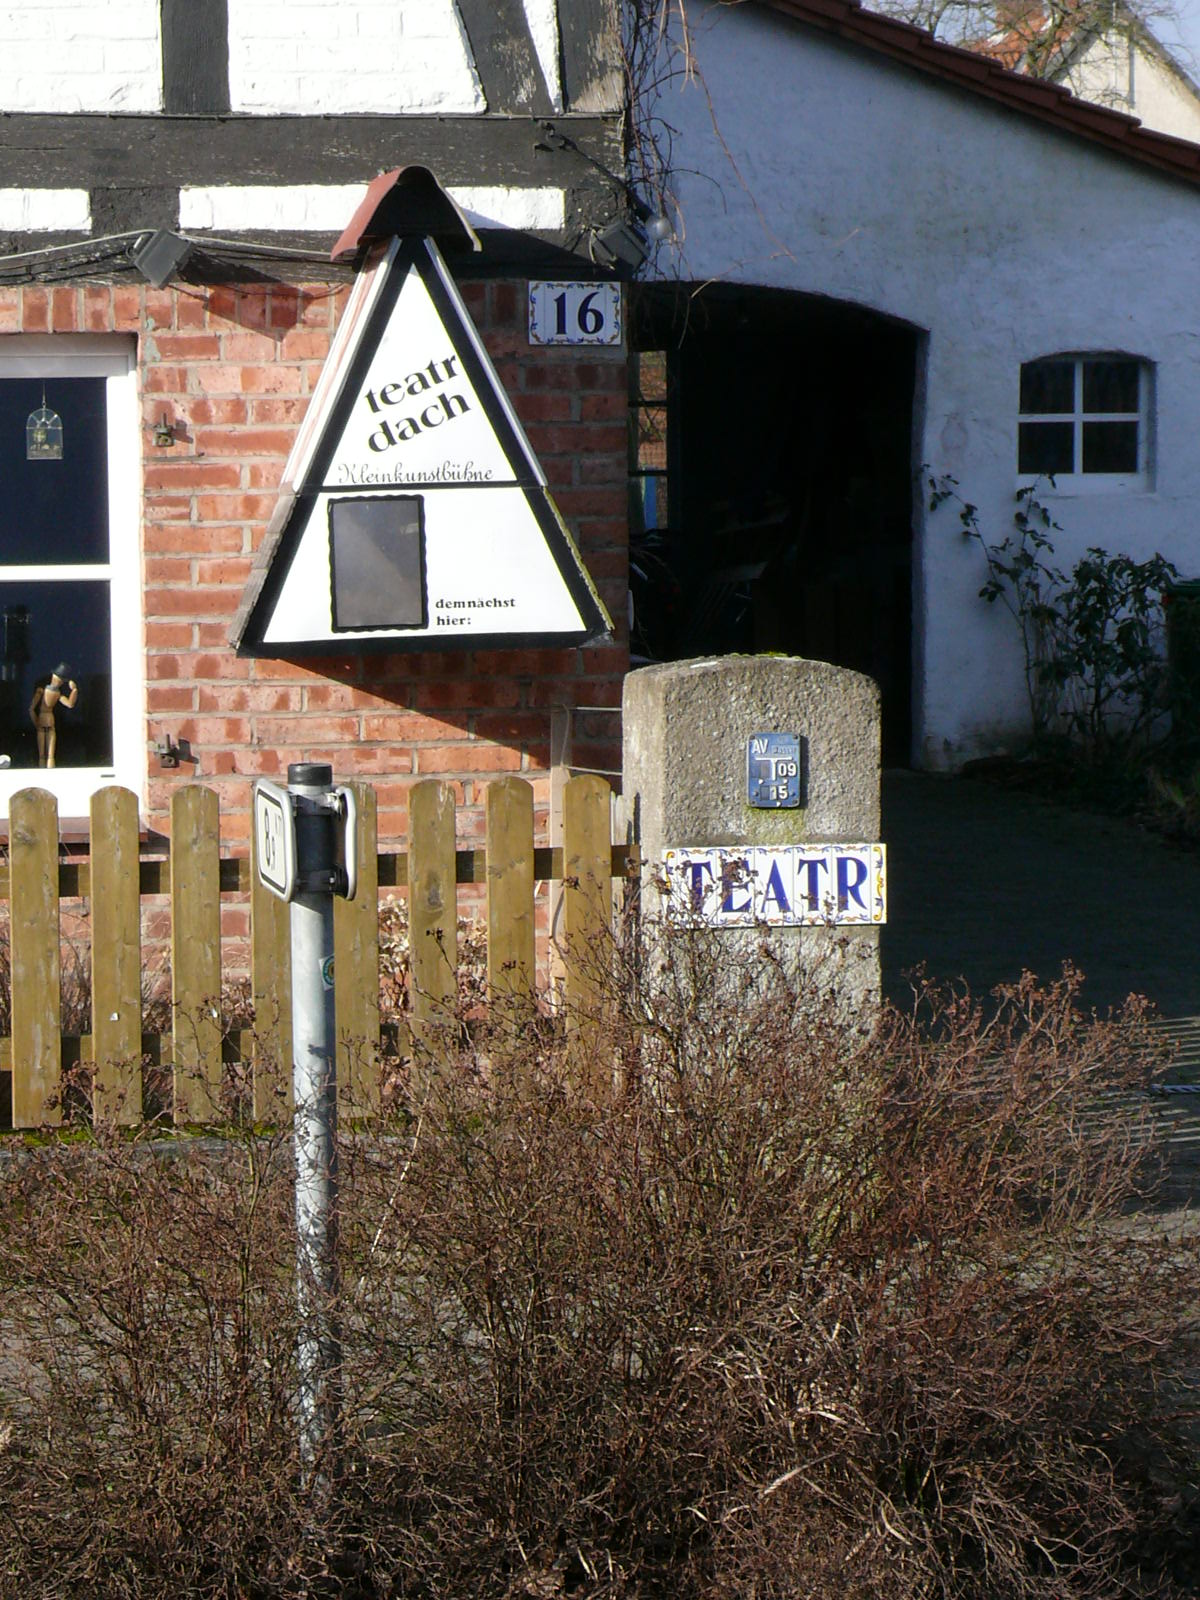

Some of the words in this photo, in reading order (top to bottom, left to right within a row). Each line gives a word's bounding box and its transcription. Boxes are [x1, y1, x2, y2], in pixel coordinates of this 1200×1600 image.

[553, 291, 604, 335] 16
[364, 354, 459, 414] teatr
[367, 392, 472, 453] dach
[338, 460, 494, 484] Kleinkunstbühne
[435, 597, 516, 609] demnächst
[436, 615, 472, 626] hier:
[751, 739, 768, 754] AV
[778, 763, 797, 777] 09
[770, 785, 788, 800] 15
[681, 856, 869, 914] TEATR
